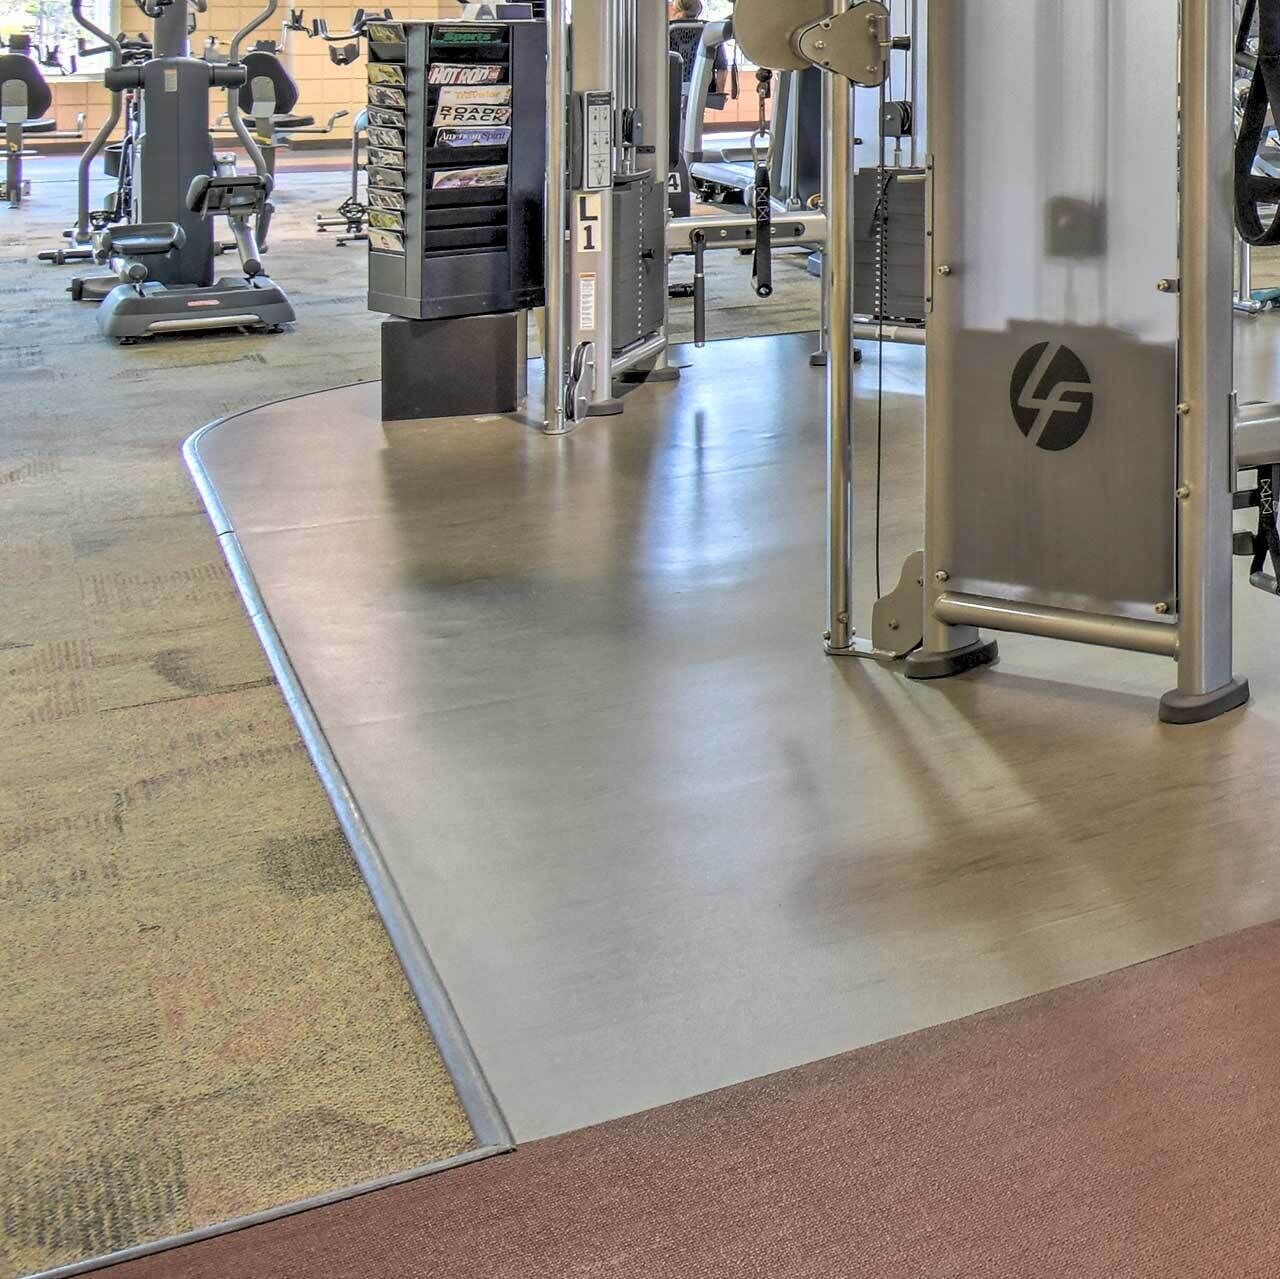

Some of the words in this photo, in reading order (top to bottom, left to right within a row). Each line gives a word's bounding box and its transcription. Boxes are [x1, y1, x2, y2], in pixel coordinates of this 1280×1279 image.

[440, 106, 494, 115] ROAD
[440, 113, 502, 121] TRACK
[668, 173, 679, 190] 4
[580, 196, 598, 221] L
[584, 225, 595, 249] 1
